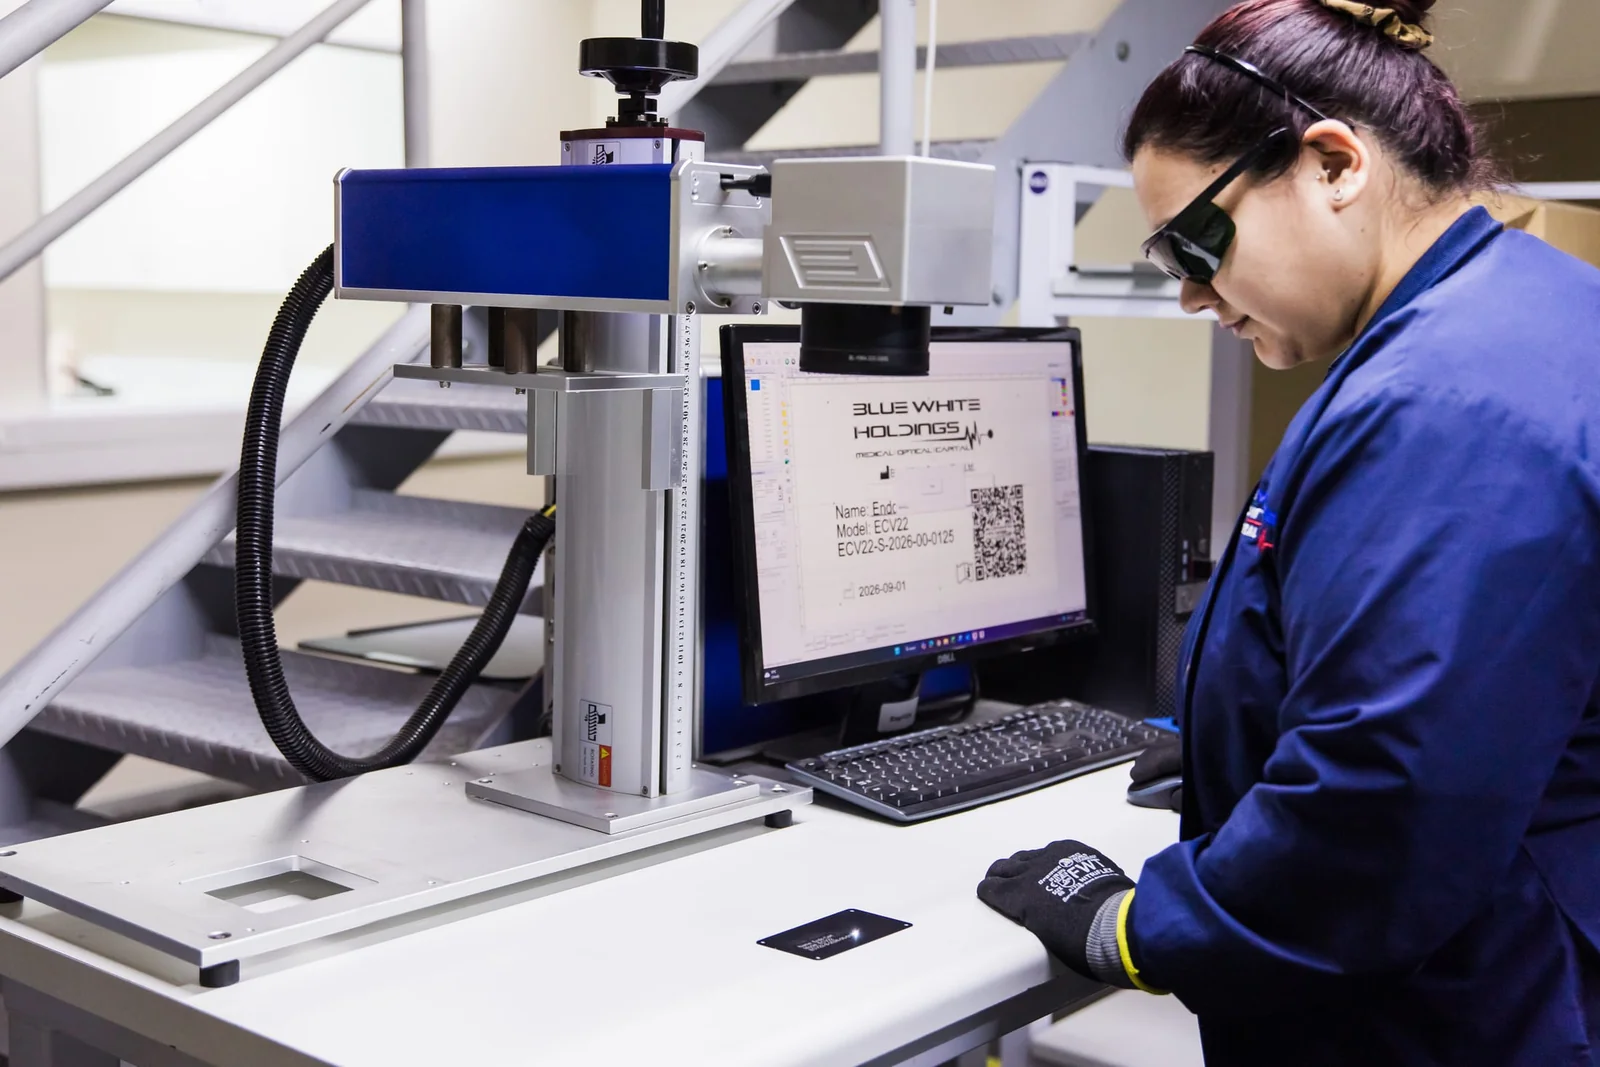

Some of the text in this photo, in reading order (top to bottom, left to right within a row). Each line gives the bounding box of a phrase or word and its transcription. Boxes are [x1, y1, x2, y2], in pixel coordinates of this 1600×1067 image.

[852, 398, 980, 416] BLUE WHITE
[854, 422, 960, 439] HOLDINGS
[856, 450, 894, 459] MEDICAL
[897, 448, 932, 456] OPTICAL
[836, 504, 868, 520] Name:
[836, 517, 909, 538] Model: ECV22
[838, 529, 954, 558] ECV22-S-2026-00-0125
[859, 580, 906, 598] 2026-09-01
[937, 652, 956, 665] DELL
[1067, 858, 1105, 878] FWT
